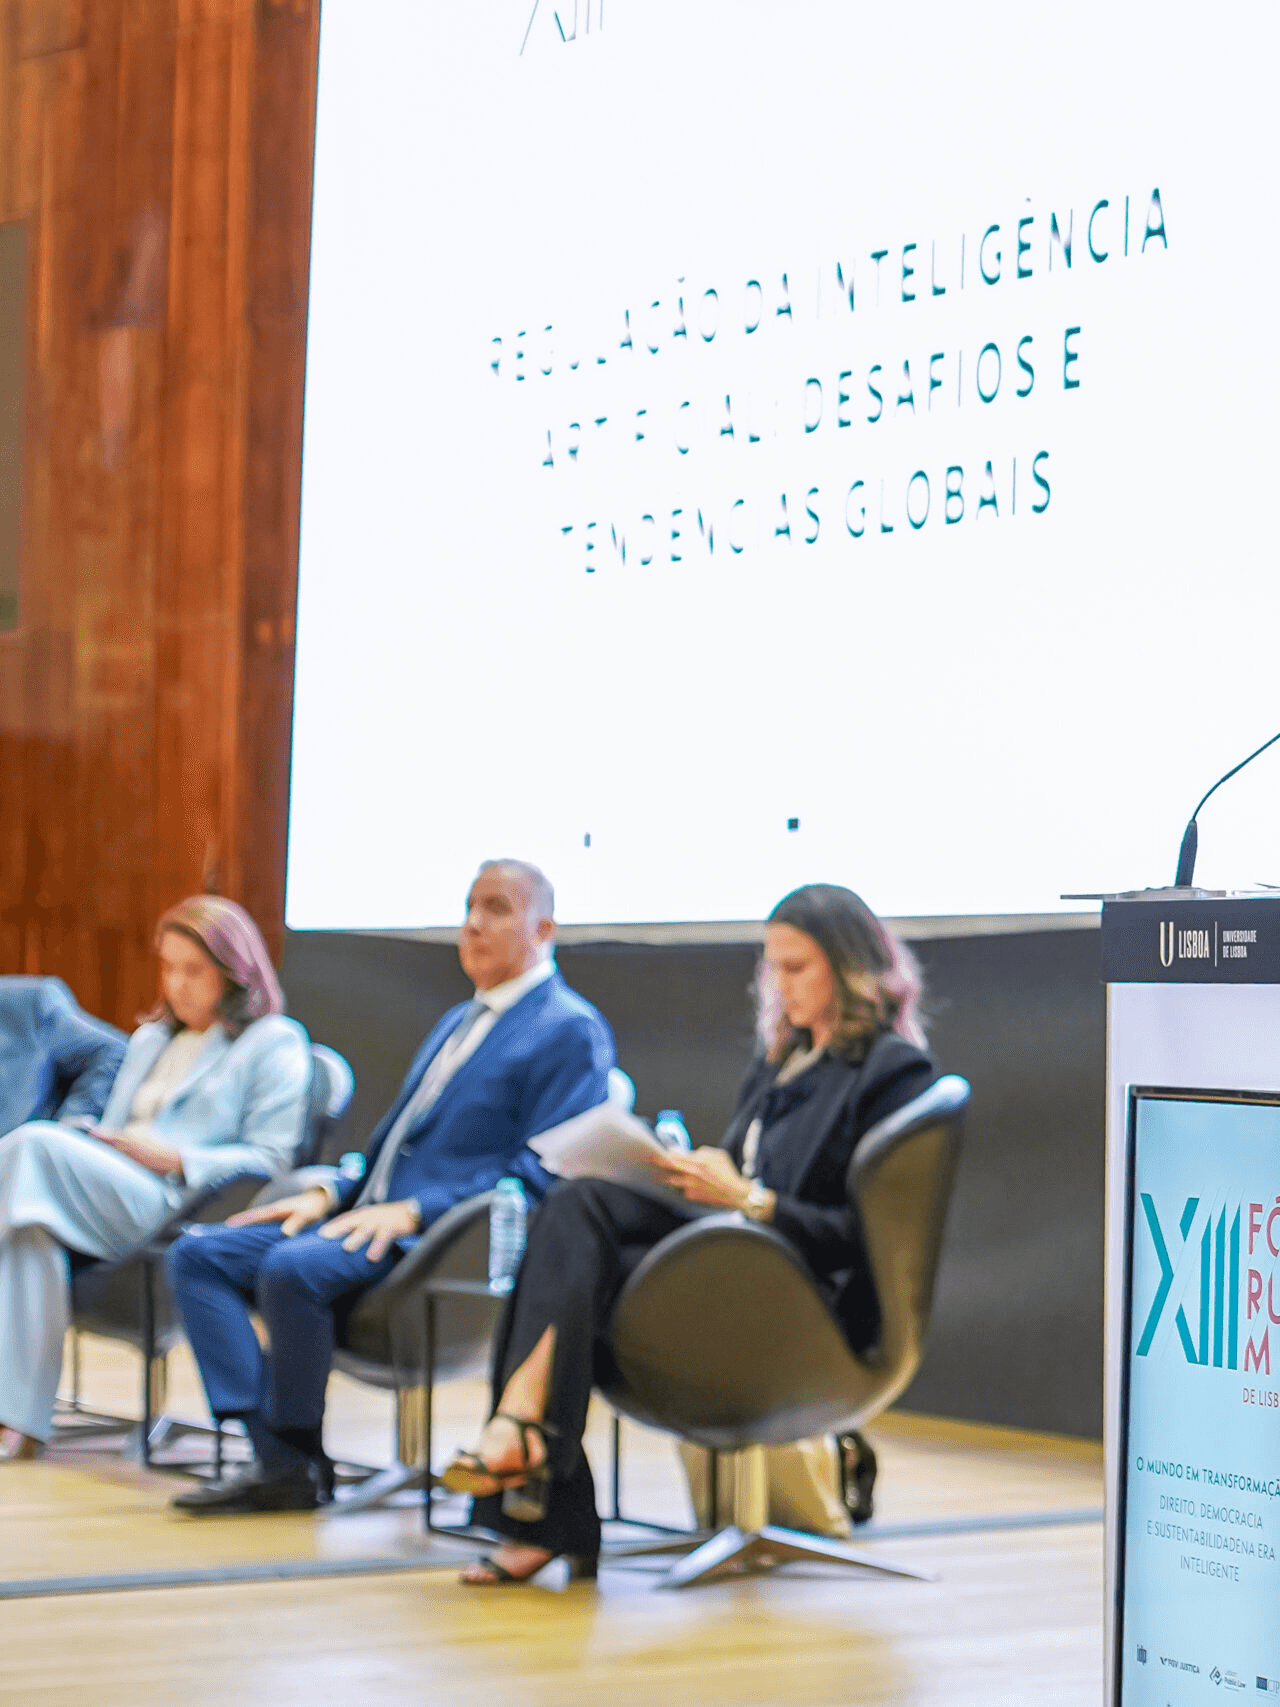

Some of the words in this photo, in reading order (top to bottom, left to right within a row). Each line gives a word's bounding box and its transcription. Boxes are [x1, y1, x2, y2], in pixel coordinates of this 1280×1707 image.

[745, 272, 792, 334] DA
[804, 335, 1035, 434] DESAFIOS
[1063, 325, 1081, 389] E
[845, 450, 1051, 538] GLOBAIS
[1178, 930, 1209, 958] LISBOA
[1222, 930, 1257, 943] UNIVERSIDADE
[1222, 945, 1229, 958] DE
[1231, 946, 1247, 958] LISBOA
[1242, 1387, 1256, 1405] DE
[1136, 1456, 1144, 1471] O
[1146, 1459, 1183, 1479] MUNDO
[1186, 1465, 1200, 1482] EM
[1200, 1502, 1263, 1530] DEMOCRACIA
[1147, 1519, 1153, 1535] E
[1257, 1543, 1276, 1561] ERA
[1180, 1554, 1240, 1582] INTELIGENTE
